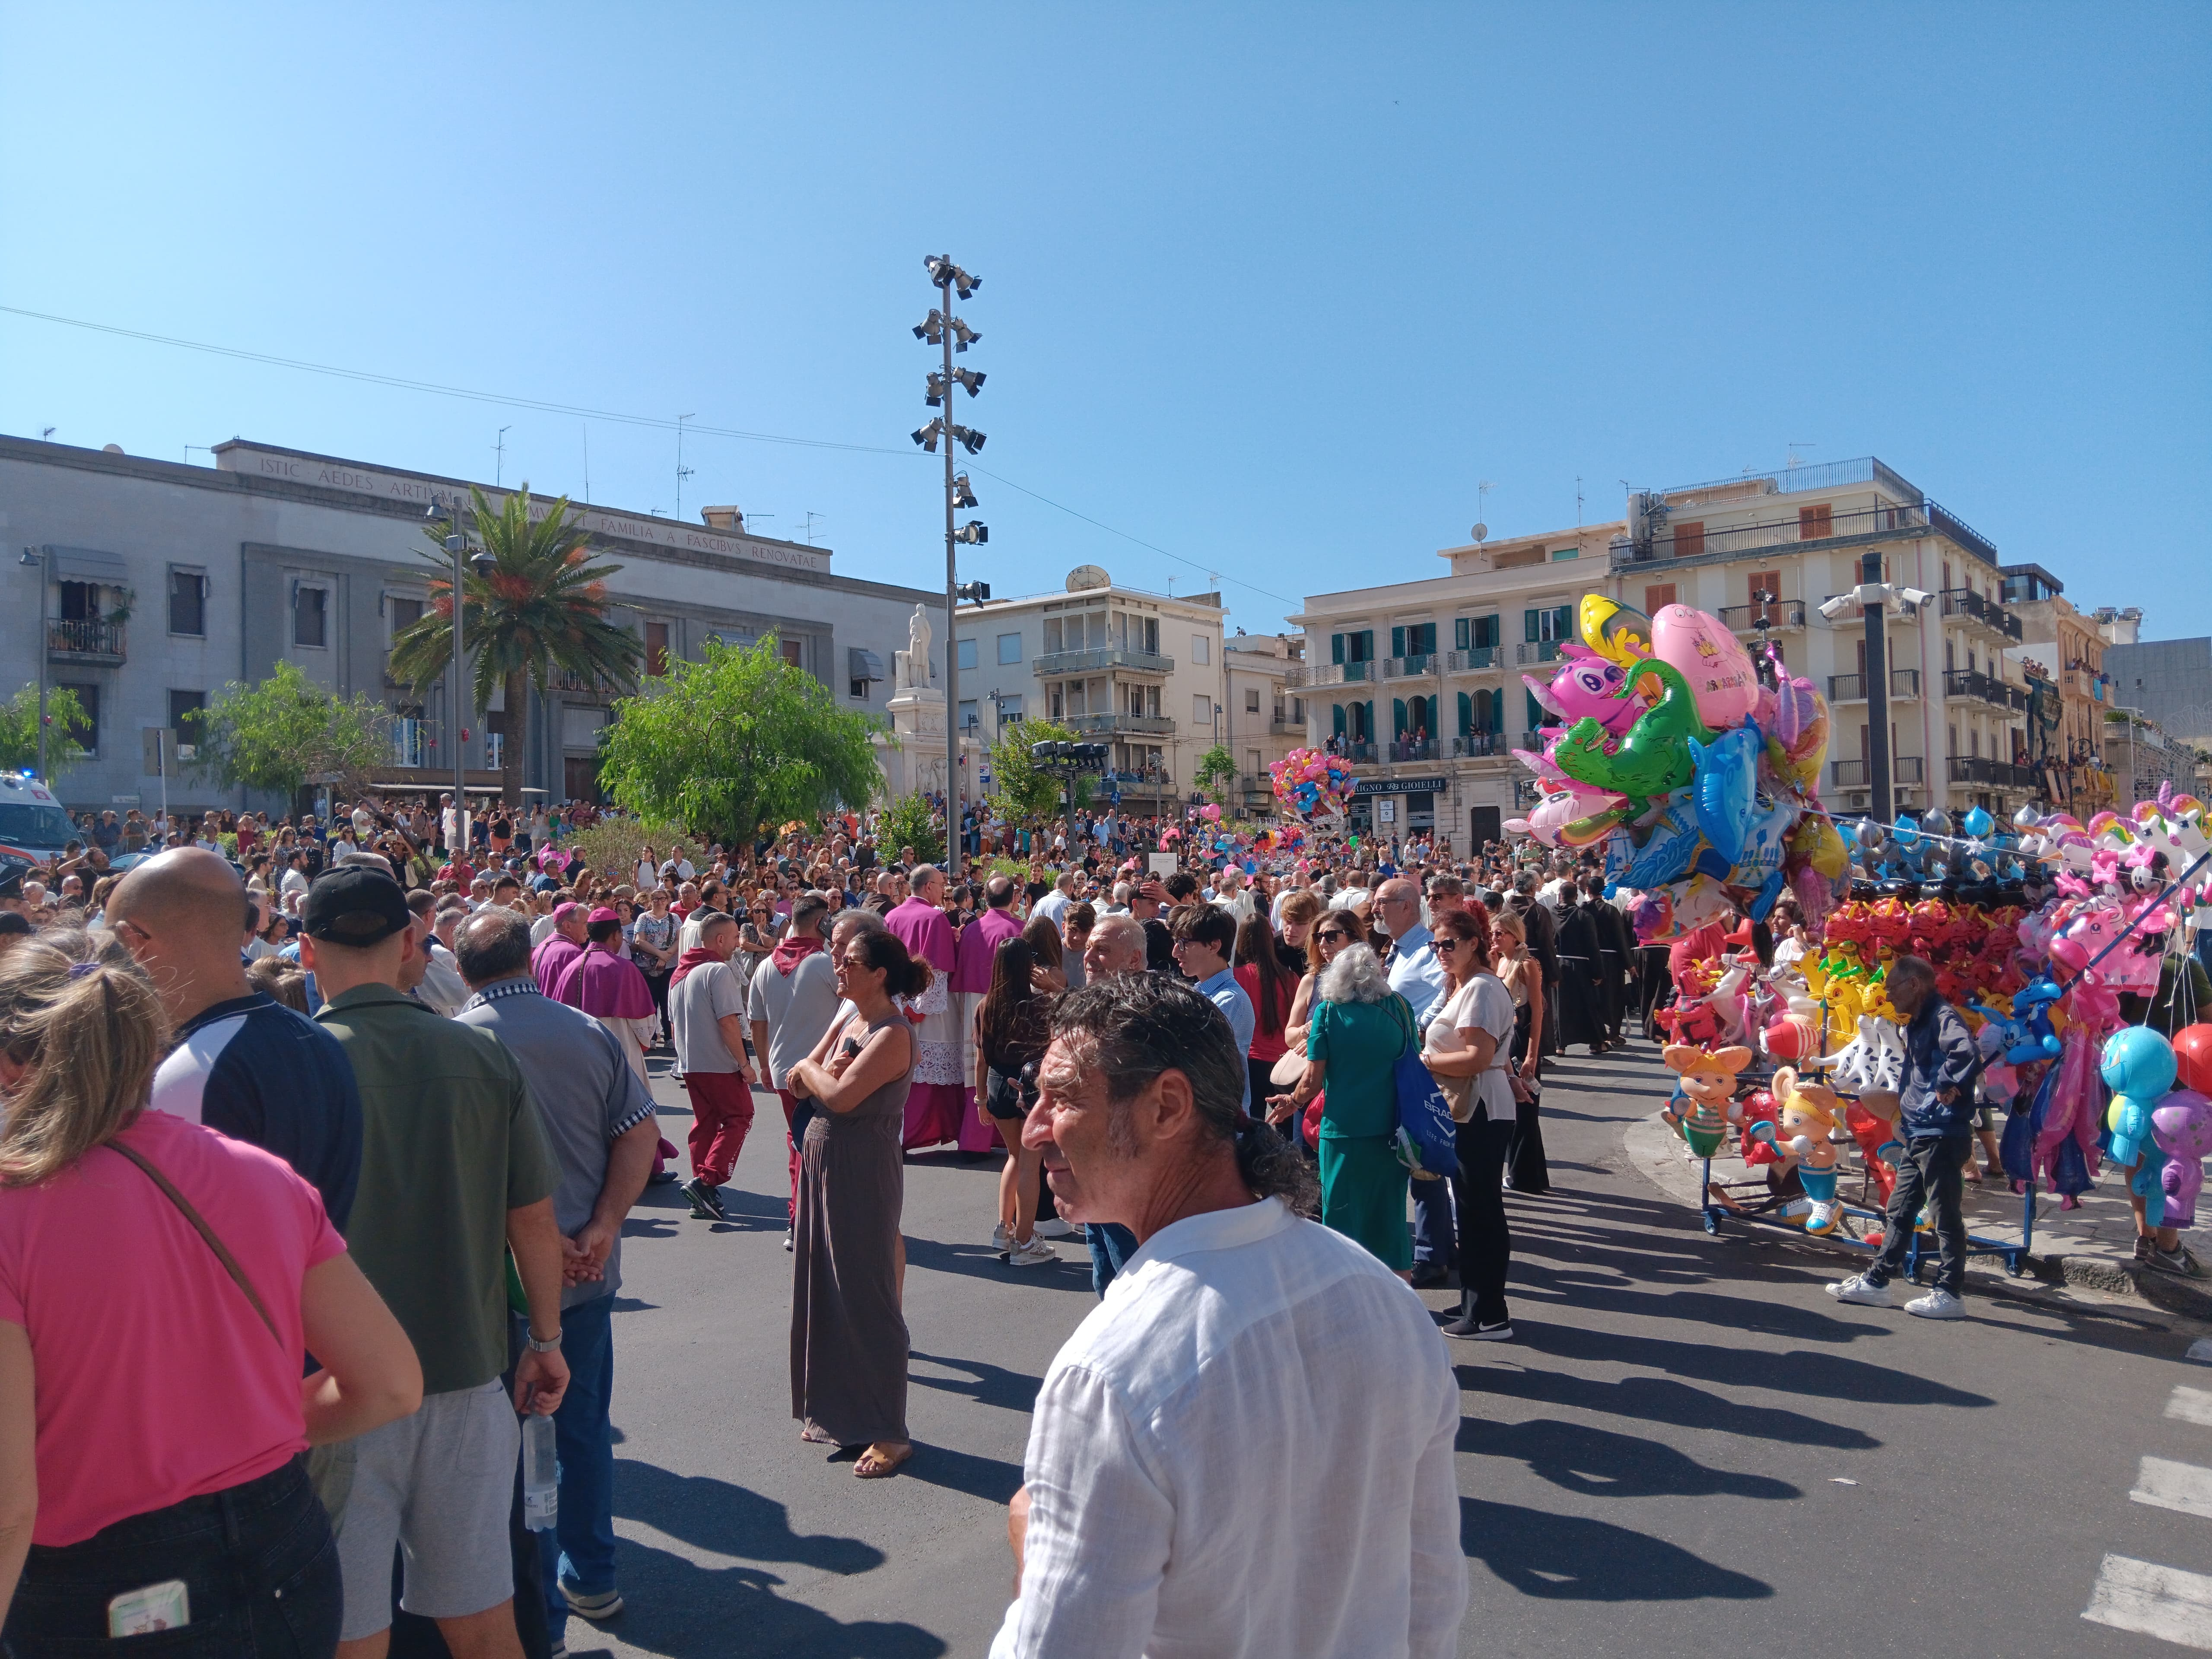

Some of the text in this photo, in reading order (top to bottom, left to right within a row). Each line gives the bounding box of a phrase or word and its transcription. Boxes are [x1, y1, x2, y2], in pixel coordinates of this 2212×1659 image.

[261, 458, 300, 477] ISTIC
[318, 470, 373, 490] AEDES
[601, 518, 653, 539] FAMILIA
[667, 532, 675, 543] A
[687, 534, 741, 554] FASCIBVS
[752, 546, 817, 568] RENOVATAE
[1401, 780, 1442, 789] GIOIELLI
[1427, 1130, 1437, 1141] LIFE
